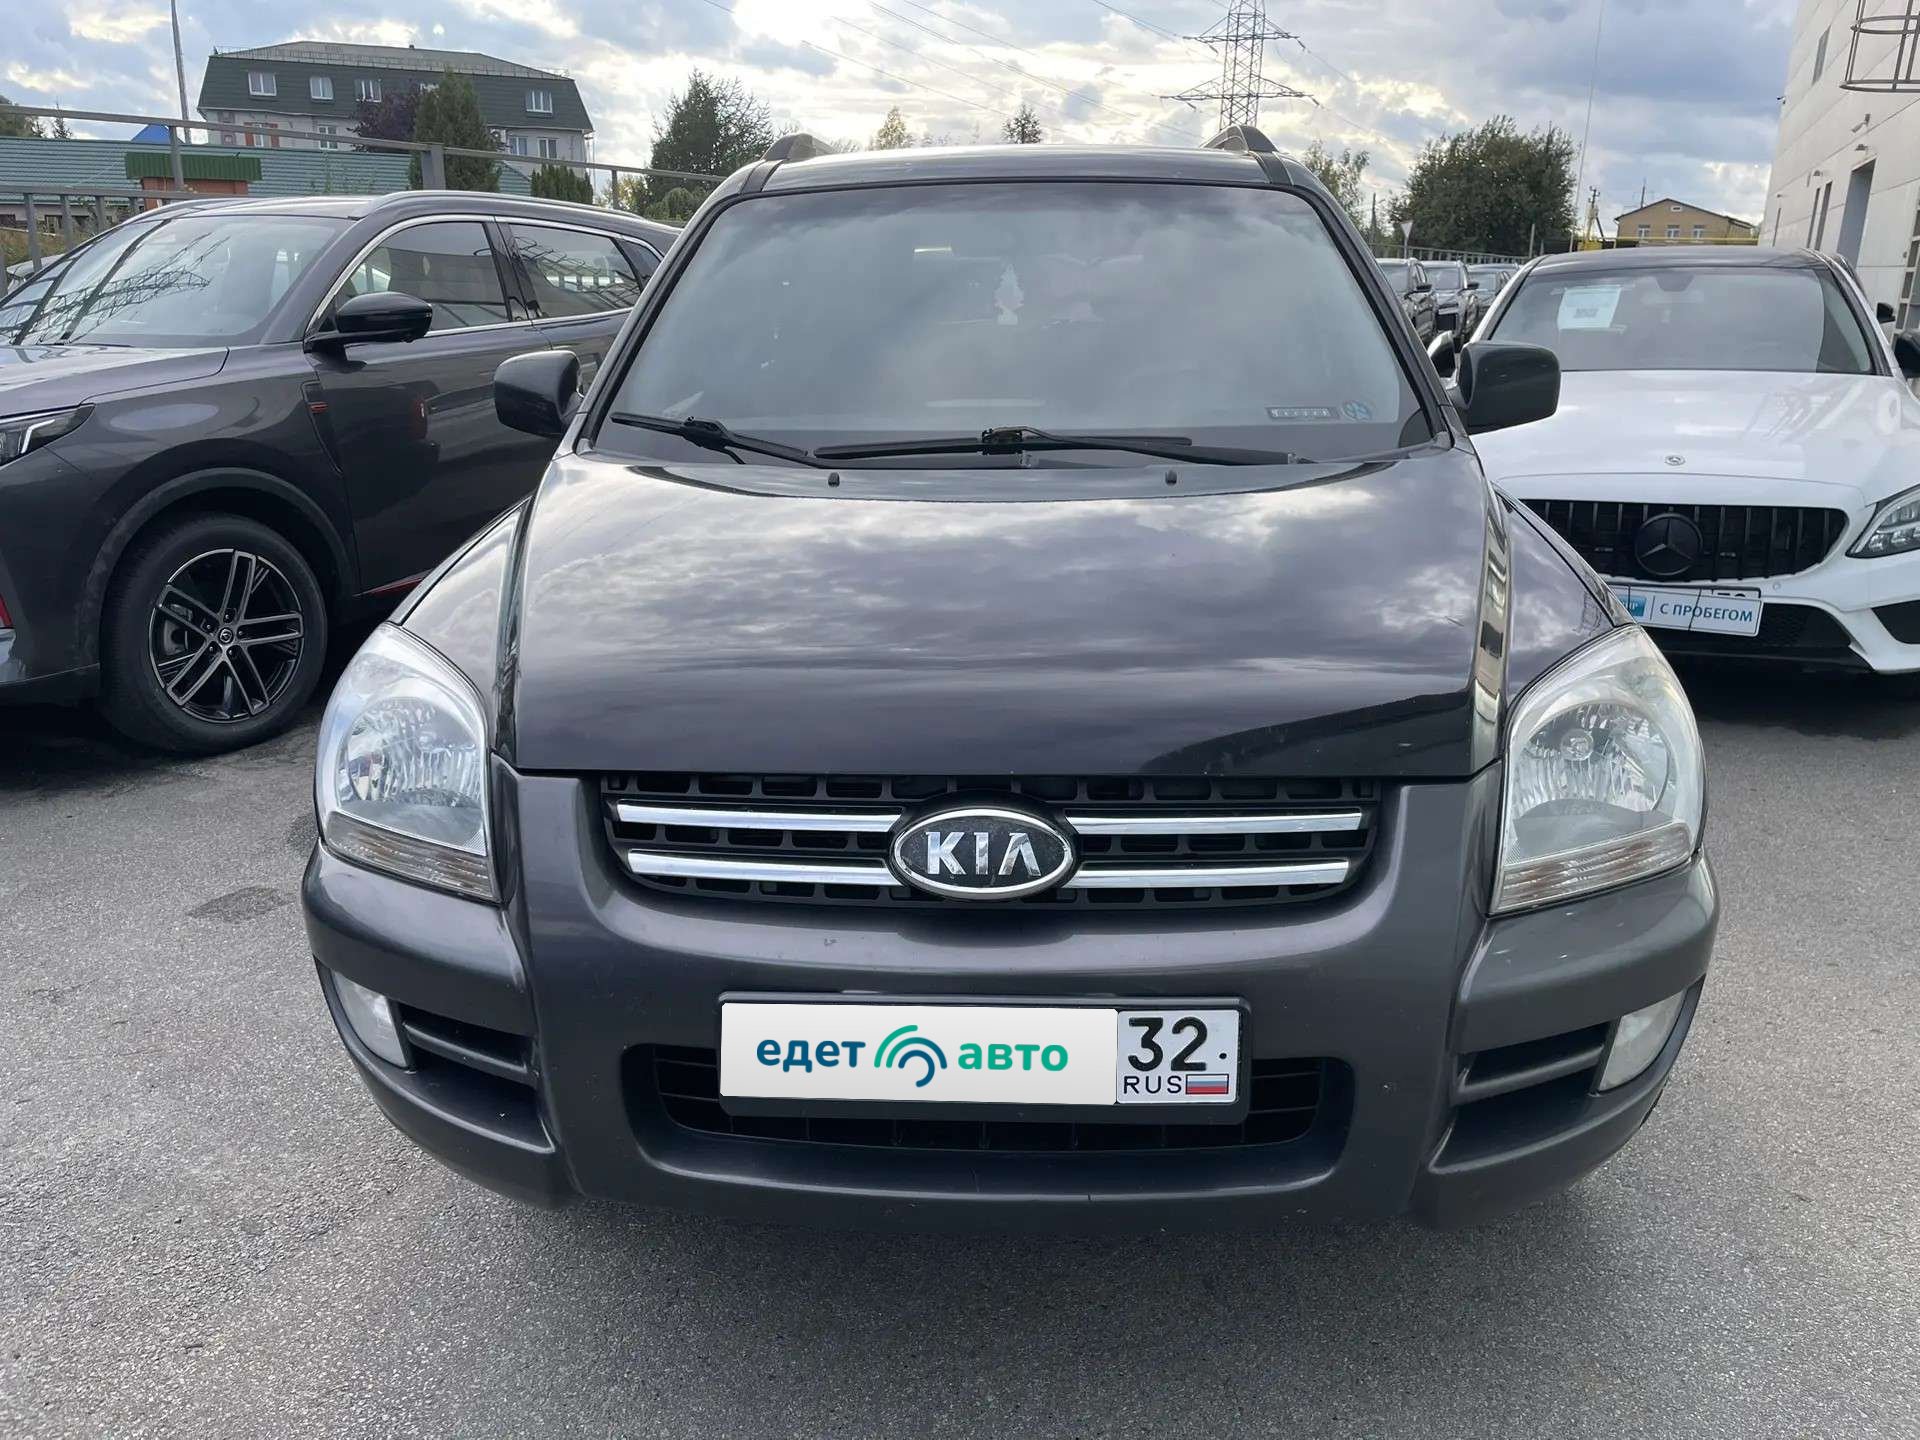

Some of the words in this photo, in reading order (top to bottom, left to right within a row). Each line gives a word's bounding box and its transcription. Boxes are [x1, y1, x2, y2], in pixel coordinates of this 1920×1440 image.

[1660, 603, 1669, 615] С
[1672, 604, 1753, 621] ПРОБЕГОМ
[925, 831, 1041, 876] KIA
[1128, 1016, 1208, 1072] 32
[1123, 1074, 1182, 1095] RUS
